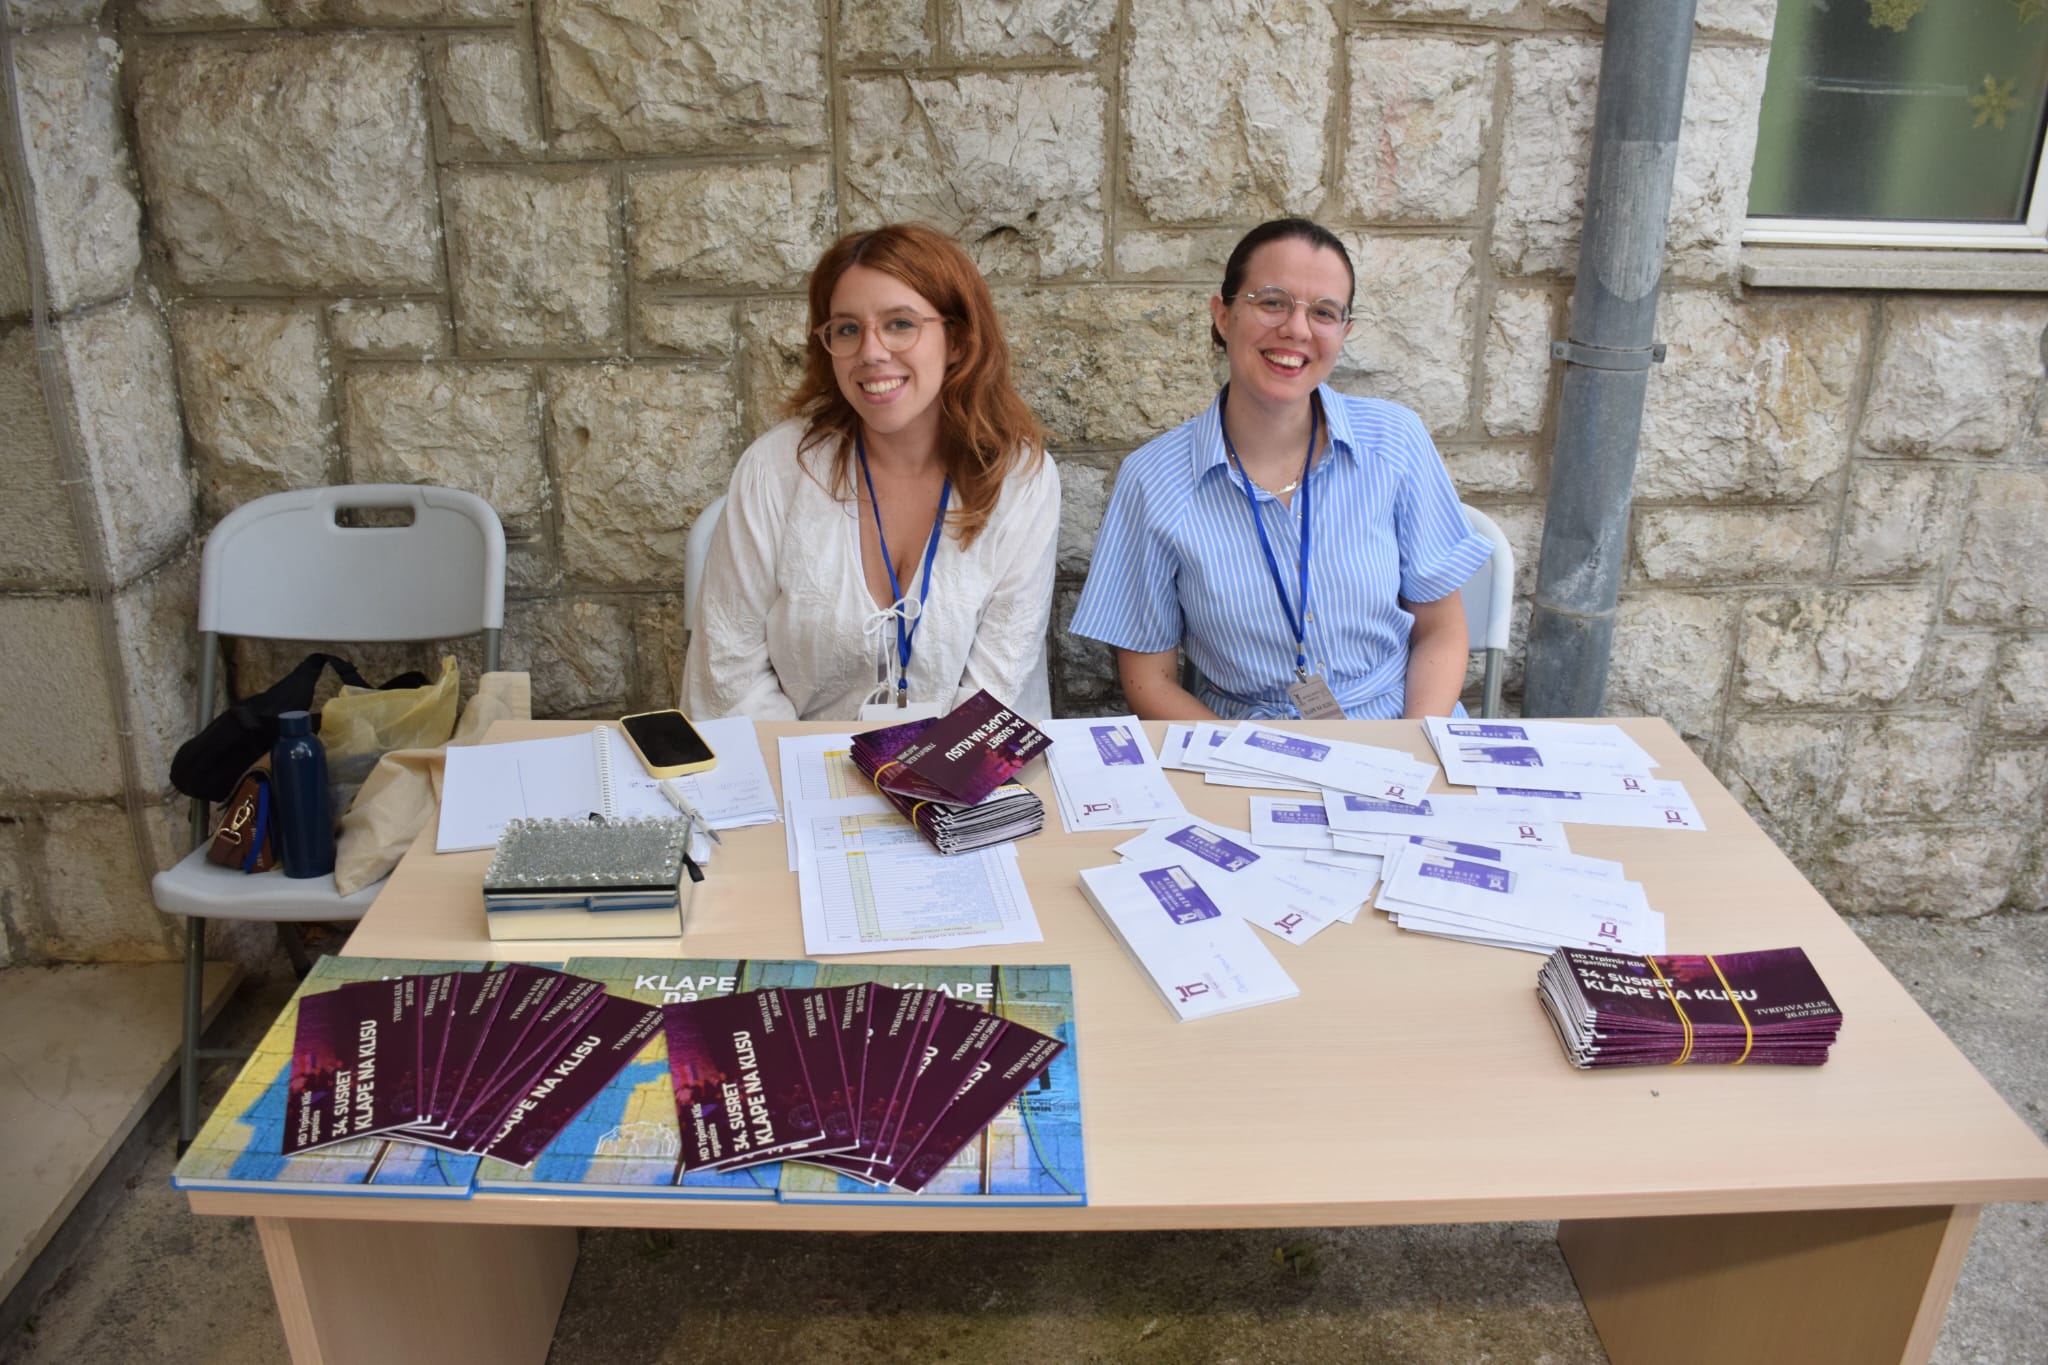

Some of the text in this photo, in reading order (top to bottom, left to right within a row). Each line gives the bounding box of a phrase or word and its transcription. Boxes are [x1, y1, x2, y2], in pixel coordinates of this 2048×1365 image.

[944, 709, 1013, 762] KLAPE NA KLISU
[986, 726, 1016, 750] SUSRET
[1570, 952, 1587, 961] HD
[1627, 959, 1647, 968] Klis
[1577, 968, 1674, 988] 34. SUSRET
[634, 974, 737, 992] KLAPE
[662, 991, 698, 1004] na
[1583, 979, 1759, 1001] KLAPE NA KLISU
[354, 1019, 378, 1131] KLAPE NA KLISU
[530, 1078, 563, 1099] NA
[553, 1035, 602, 1076] KLISU
[332, 1070, 352, 1138] 34. SUSRET
[733, 1030, 775, 1146] KLAPE NA KLISU
[722, 1082, 751, 1152] 34. SUSRET
